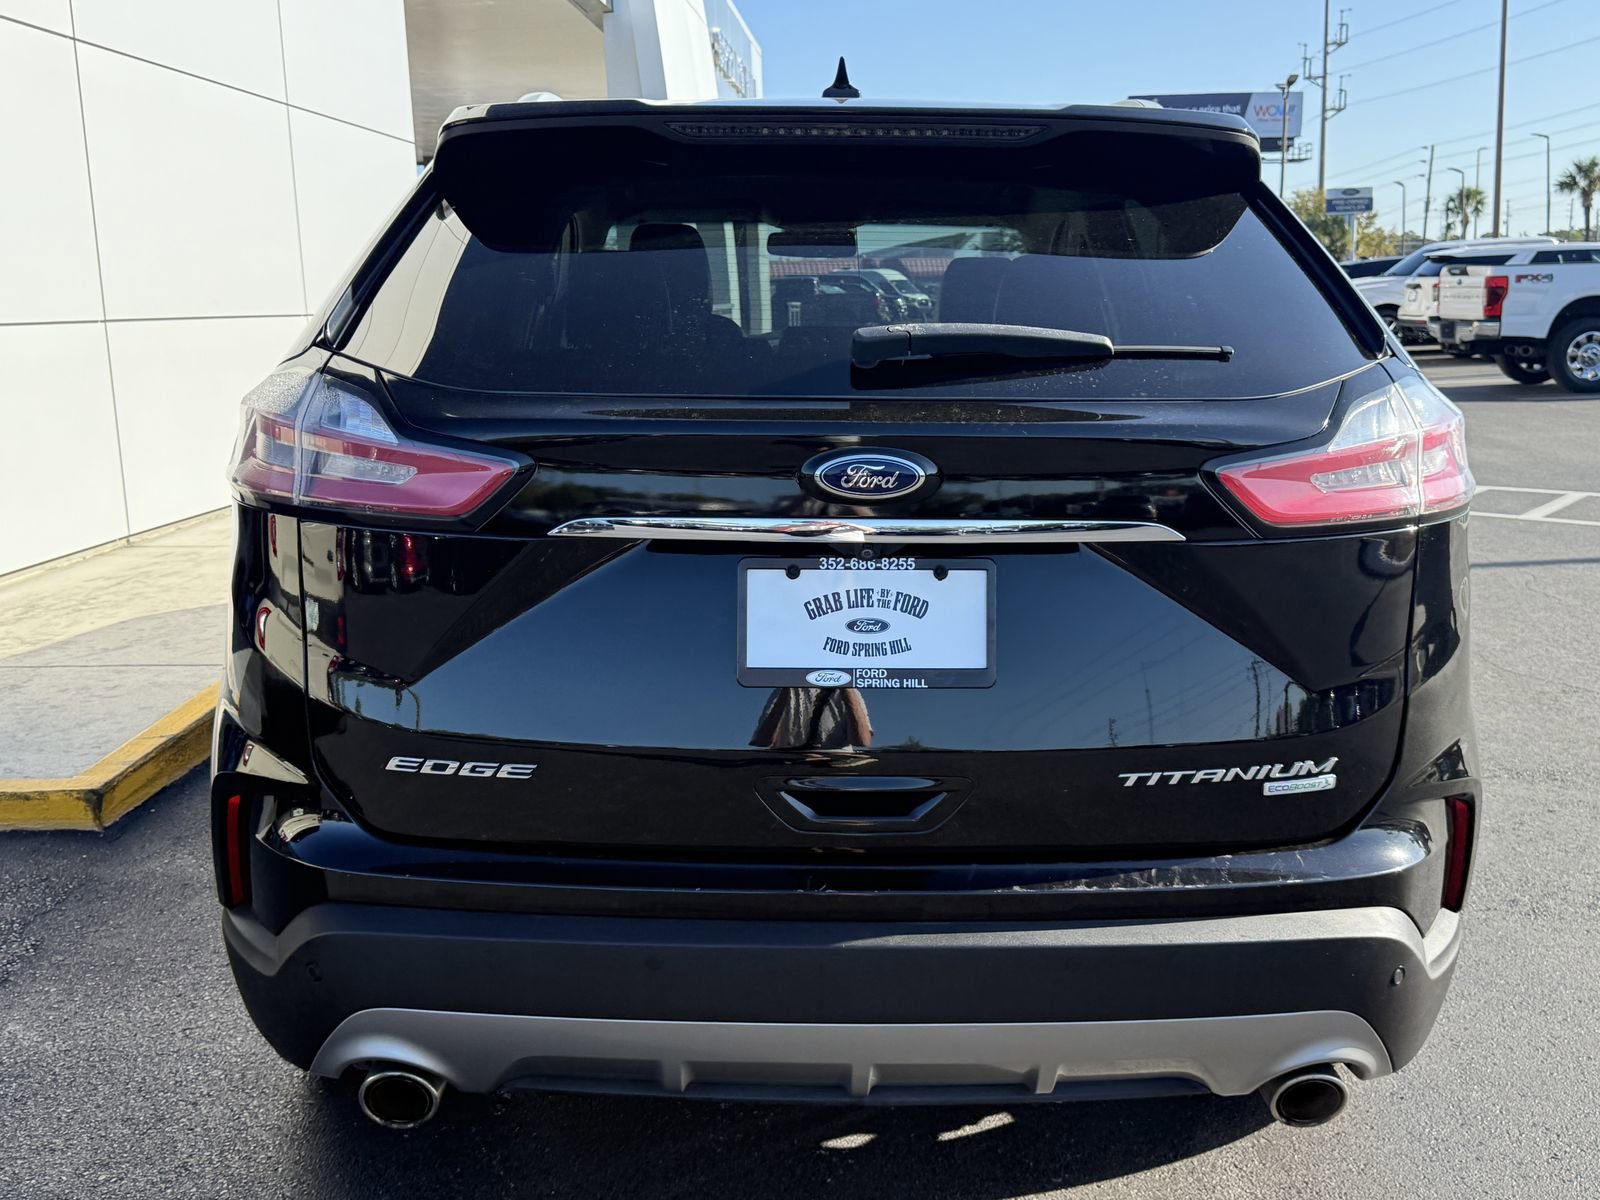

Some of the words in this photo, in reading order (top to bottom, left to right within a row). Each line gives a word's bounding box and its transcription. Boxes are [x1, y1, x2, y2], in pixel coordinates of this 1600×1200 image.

[1222, 103, 1241, 114] that
[1515, 274, 1554, 284] FX4
[840, 463, 900, 489] Ford
[819, 557, 916, 570] 352-686-8255
[845, 588, 875, 610] LIFE
[880, 588, 892, 599] BY
[803, 591, 844, 621] GRAB
[876, 598, 892, 609] THE
[892, 591, 929, 620] FORD
[853, 619, 882, 632] Ford
[822, 636, 850, 656] FORD
[851, 642, 888, 657] SPRING
[889, 637, 912, 655] HILL
[814, 672, 842, 683] Ford
[856, 668, 888, 678] FORD
[856, 678, 901, 689] SPRING
[903, 678, 929, 689] HILL
[385, 756, 538, 780] EDGE
[1118, 756, 1340, 787] TITANIUM
